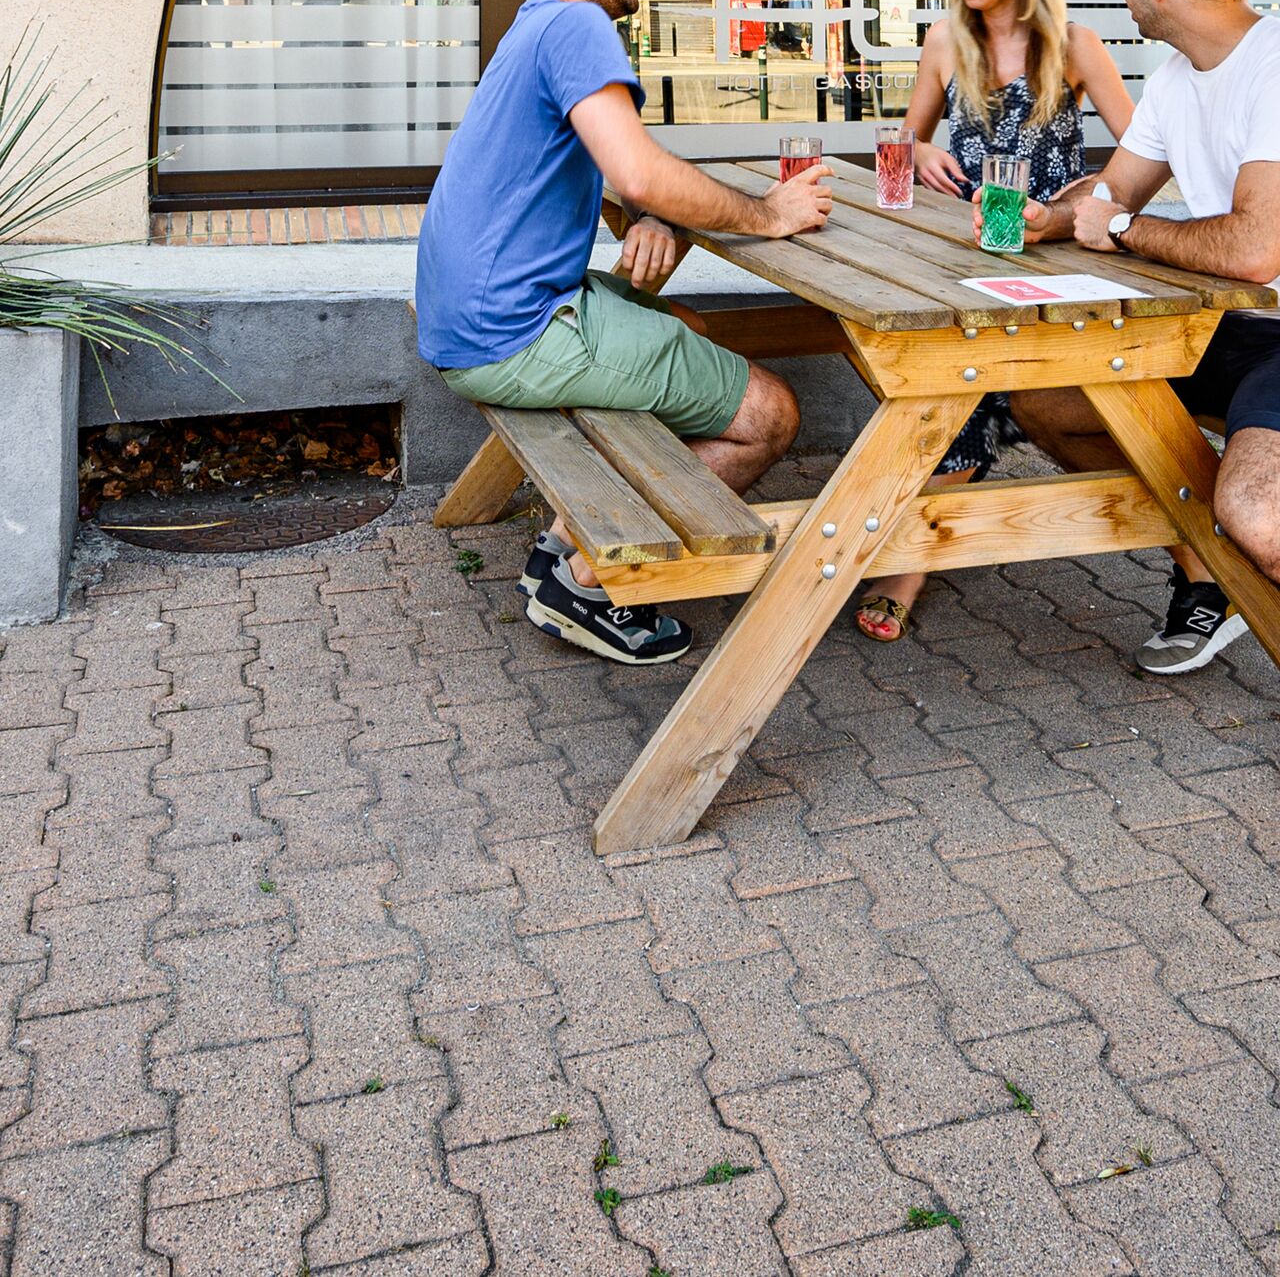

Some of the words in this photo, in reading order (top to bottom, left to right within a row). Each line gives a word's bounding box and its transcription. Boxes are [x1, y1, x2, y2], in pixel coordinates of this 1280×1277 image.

[715, 73, 803, 91] HOTEL
[813, 73, 917, 90] GASCO
[572, 601, 588, 615] 1500
